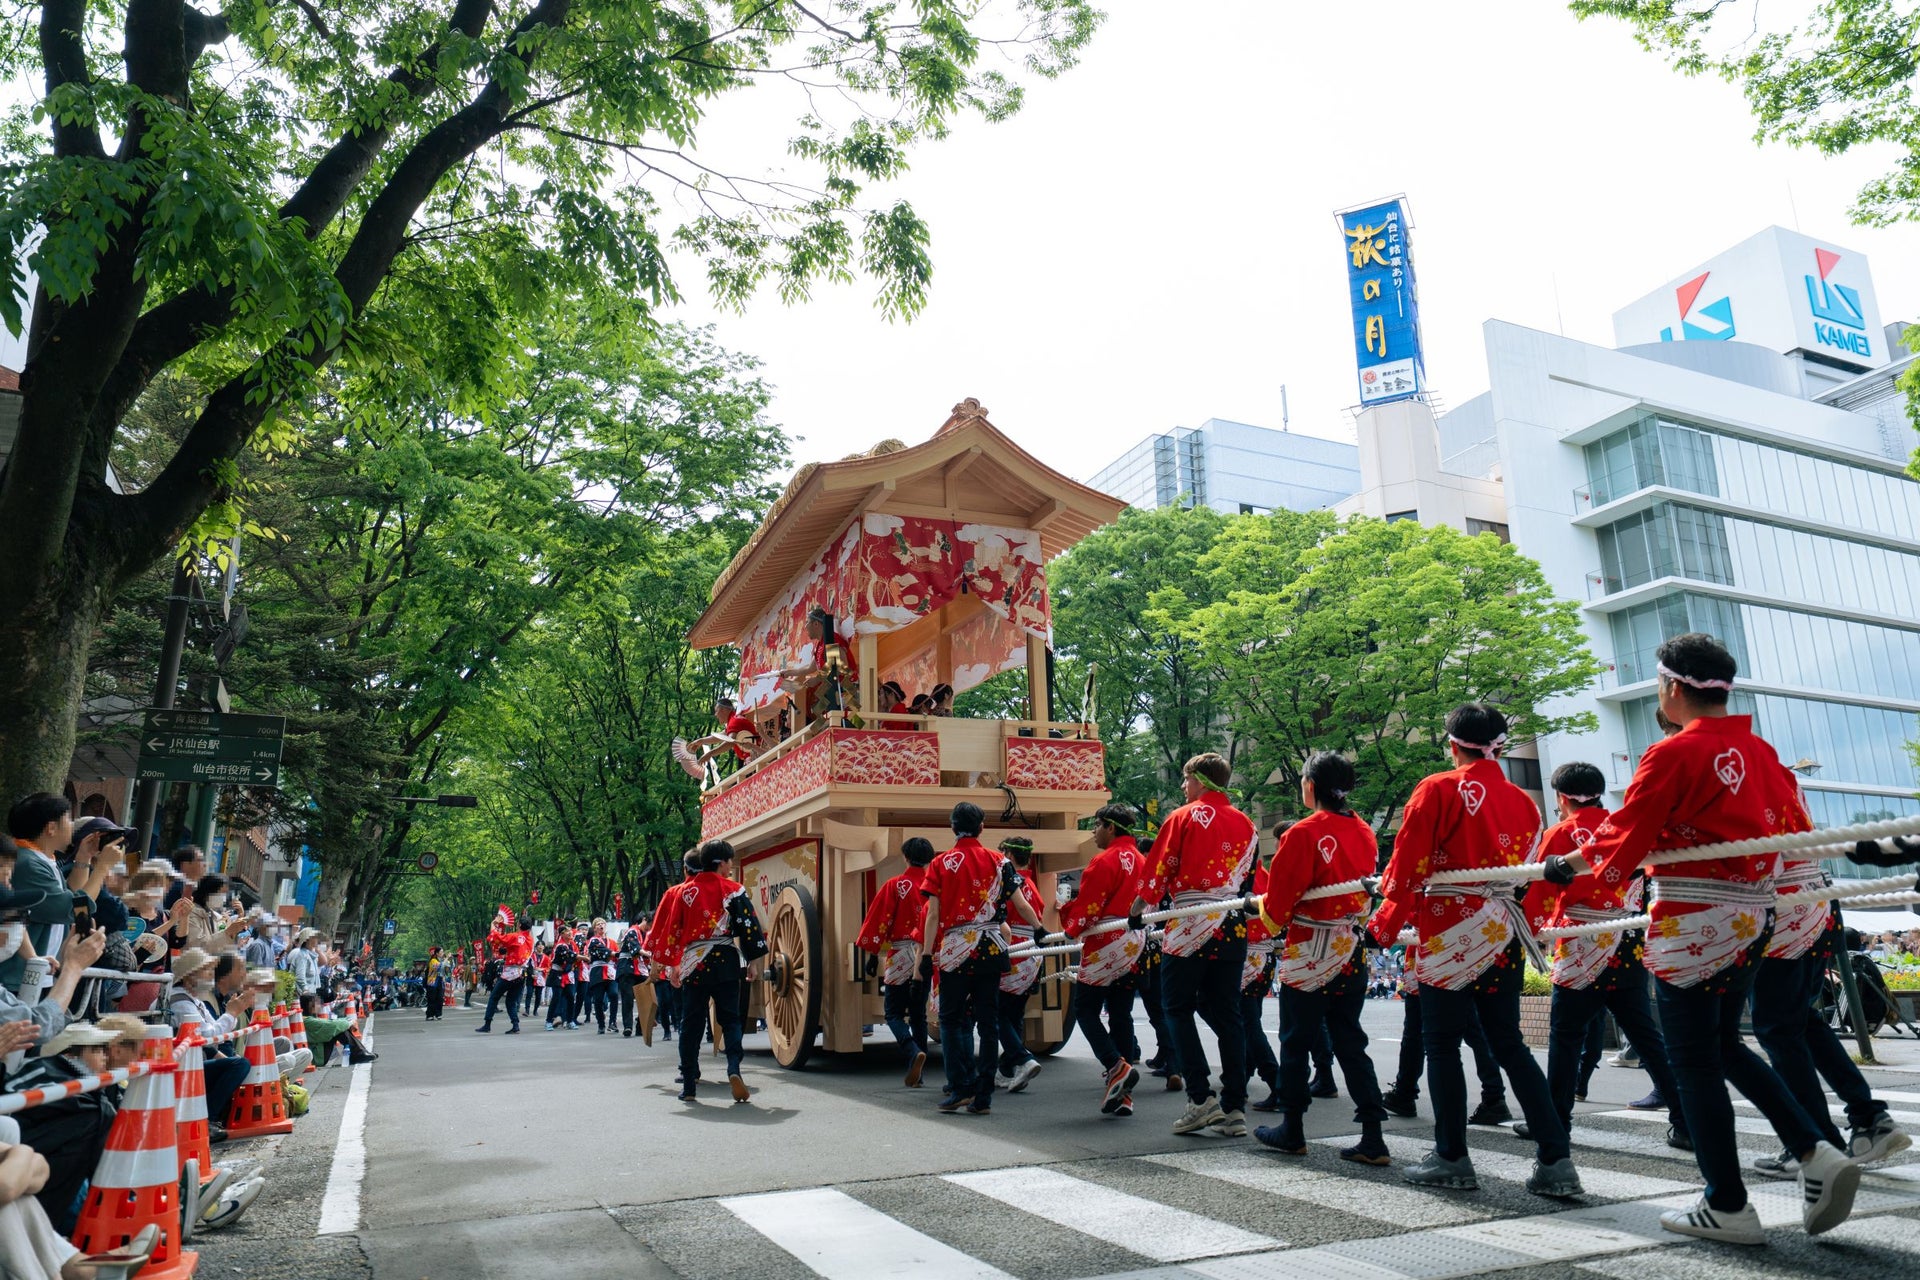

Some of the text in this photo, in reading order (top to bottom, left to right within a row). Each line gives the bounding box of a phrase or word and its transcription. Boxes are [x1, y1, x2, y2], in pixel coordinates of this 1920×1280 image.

[1345, 218, 1391, 357] 萩の月
[1815, 322, 1871, 357] KAMEI
[257, 727, 279, 735] 700m
[168, 738, 220, 750] JR仙台駅
[142, 770, 165, 778] 200m
[192, 763, 251, 776] 仙台市役所
